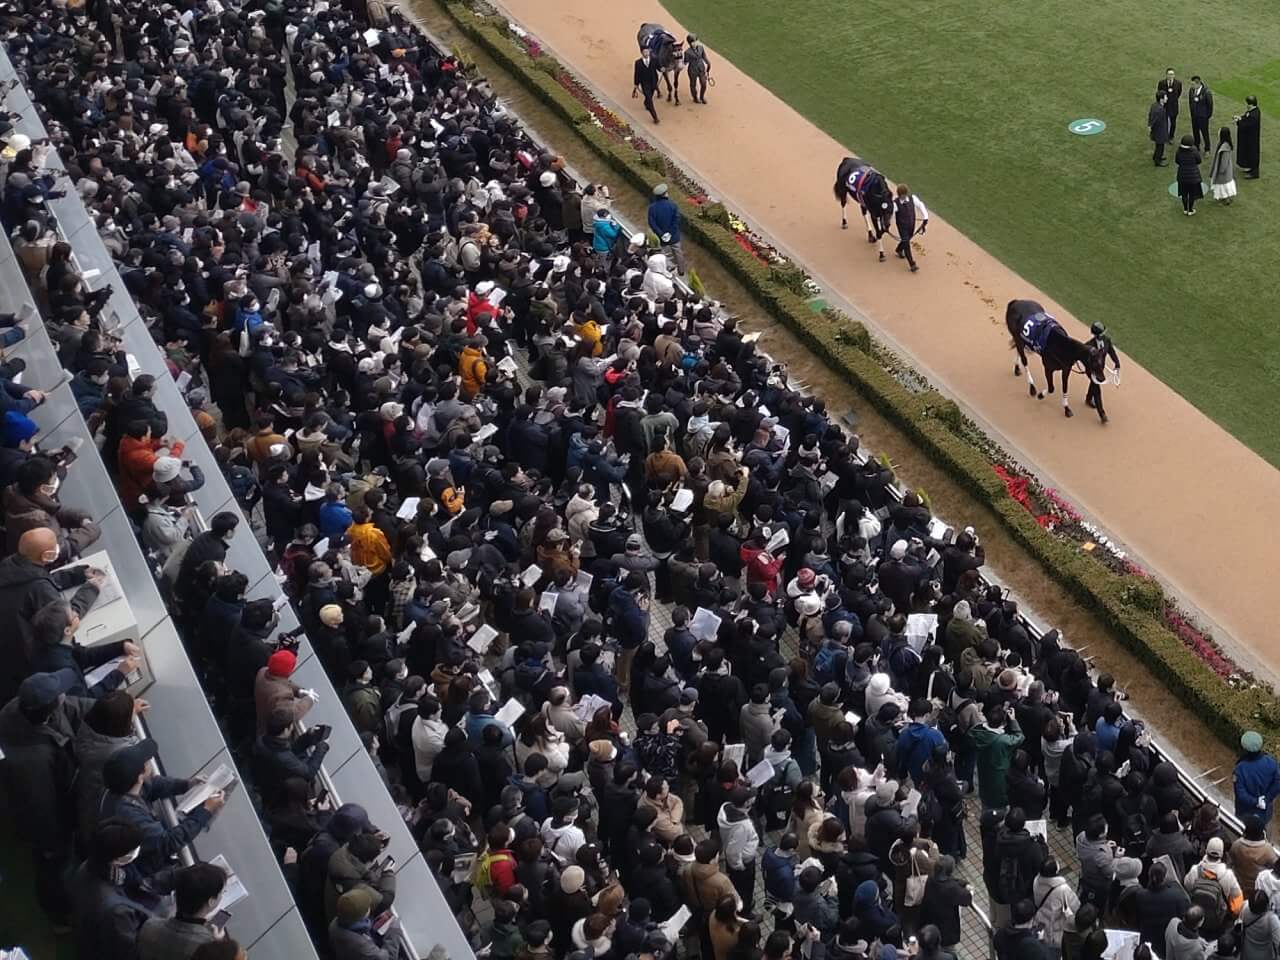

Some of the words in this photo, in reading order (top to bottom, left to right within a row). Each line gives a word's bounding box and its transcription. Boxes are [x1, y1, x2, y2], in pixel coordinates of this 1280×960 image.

[1075, 121, 1101, 131] 5
[849, 171, 860, 184] 6
[1023, 320, 1034, 336] 5
